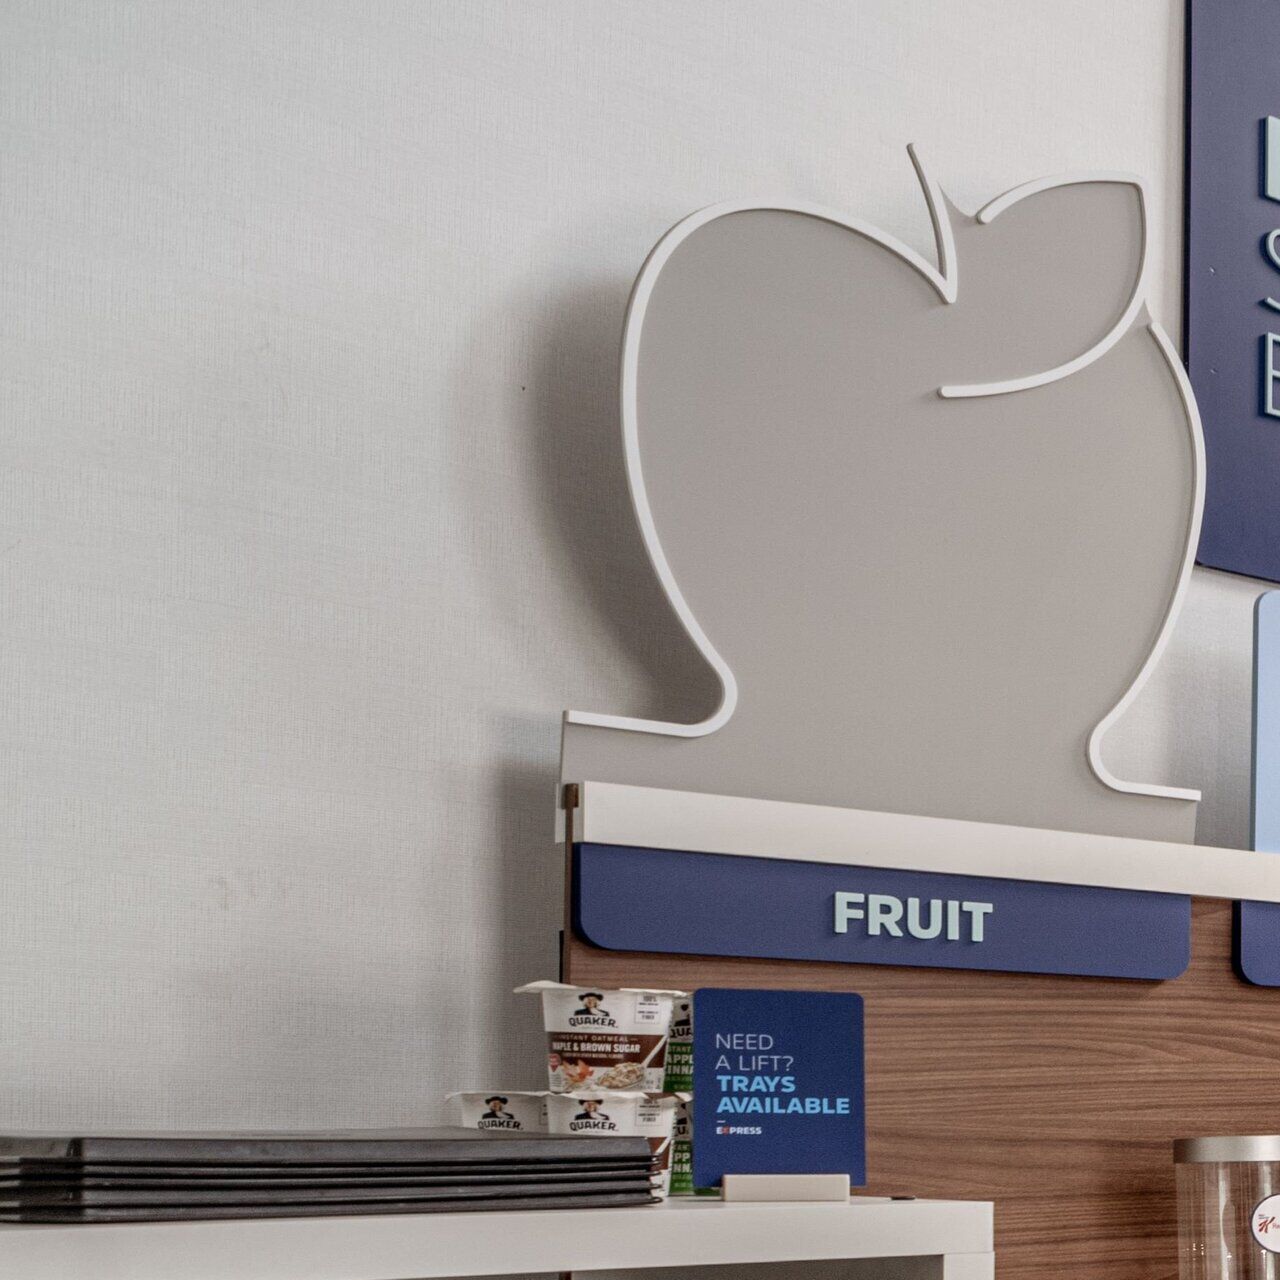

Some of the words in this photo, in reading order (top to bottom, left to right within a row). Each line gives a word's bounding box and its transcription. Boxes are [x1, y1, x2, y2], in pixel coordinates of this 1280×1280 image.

[832, 890, 994, 943] FRUIT
[568, 1016, 618, 1029] QUAKER
[580, 1042, 612, 1052] BROWN
[613, 1043, 641, 1053] SUGAR
[715, 1033, 774, 1050] NEED
[715, 1054, 731, 1070] A
[738, 1055, 795, 1071] LIFT?
[716, 1075, 796, 1093] TRAYS
[716, 1096, 850, 1114] AVAILABLE
[477, 1119, 523, 1130] QUAKER
[569, 1120, 618, 1131] QUAKER
[716, 1126, 762, 1135] EXPRESS
